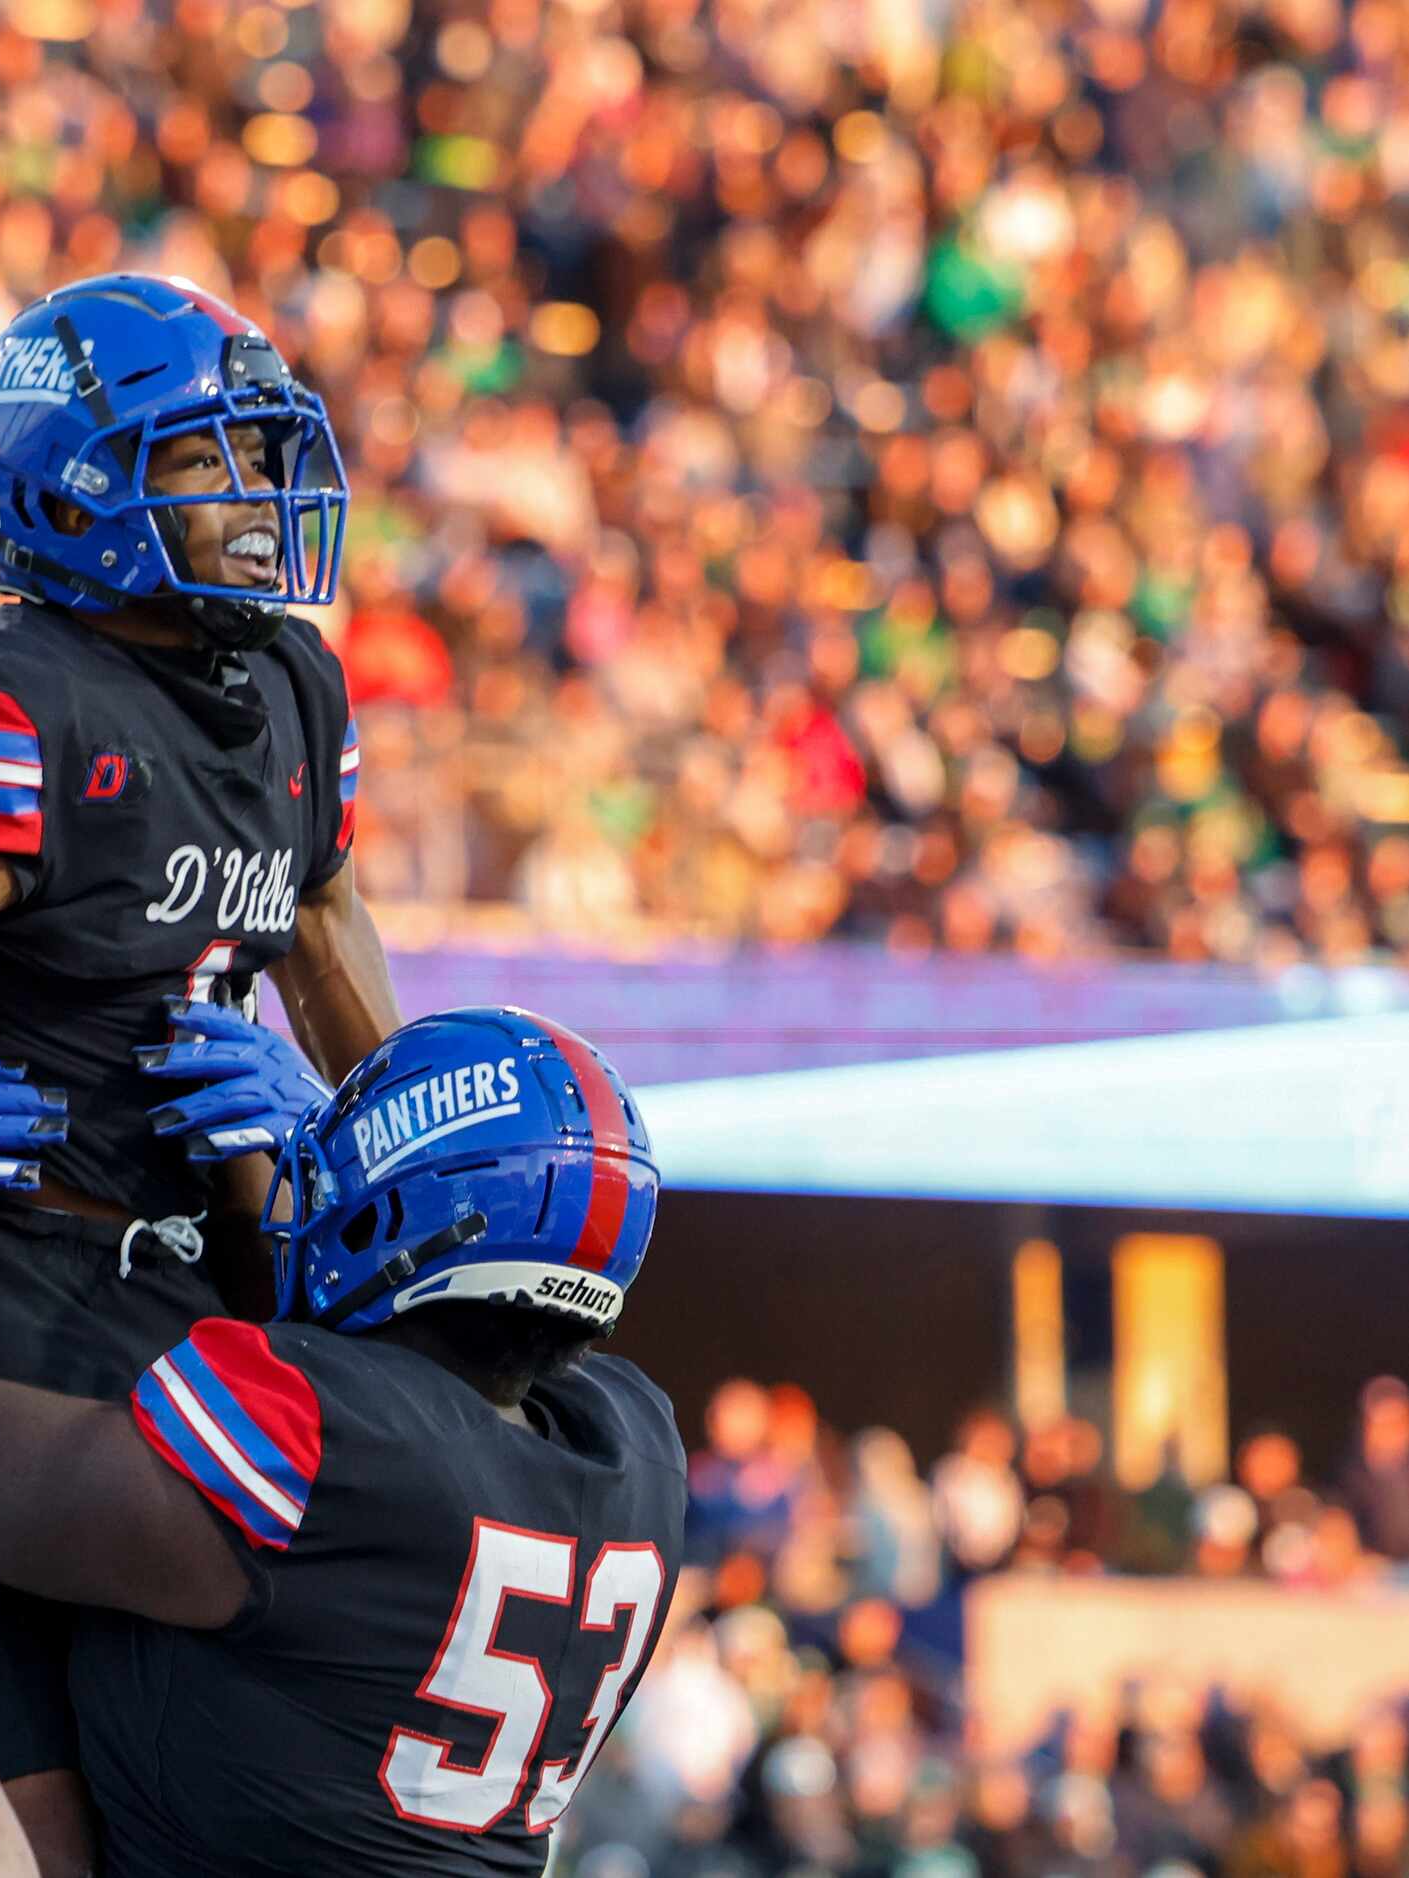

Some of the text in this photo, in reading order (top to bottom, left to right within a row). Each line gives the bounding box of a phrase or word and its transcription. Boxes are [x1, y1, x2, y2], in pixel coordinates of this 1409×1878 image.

[80, 752, 129, 802] D
[146, 844, 295, 932] D'Ville
[353, 1057, 520, 1170] PANTHERS
[535, 1275, 617, 1315] schutt
[377, 1515, 666, 1834] 53
